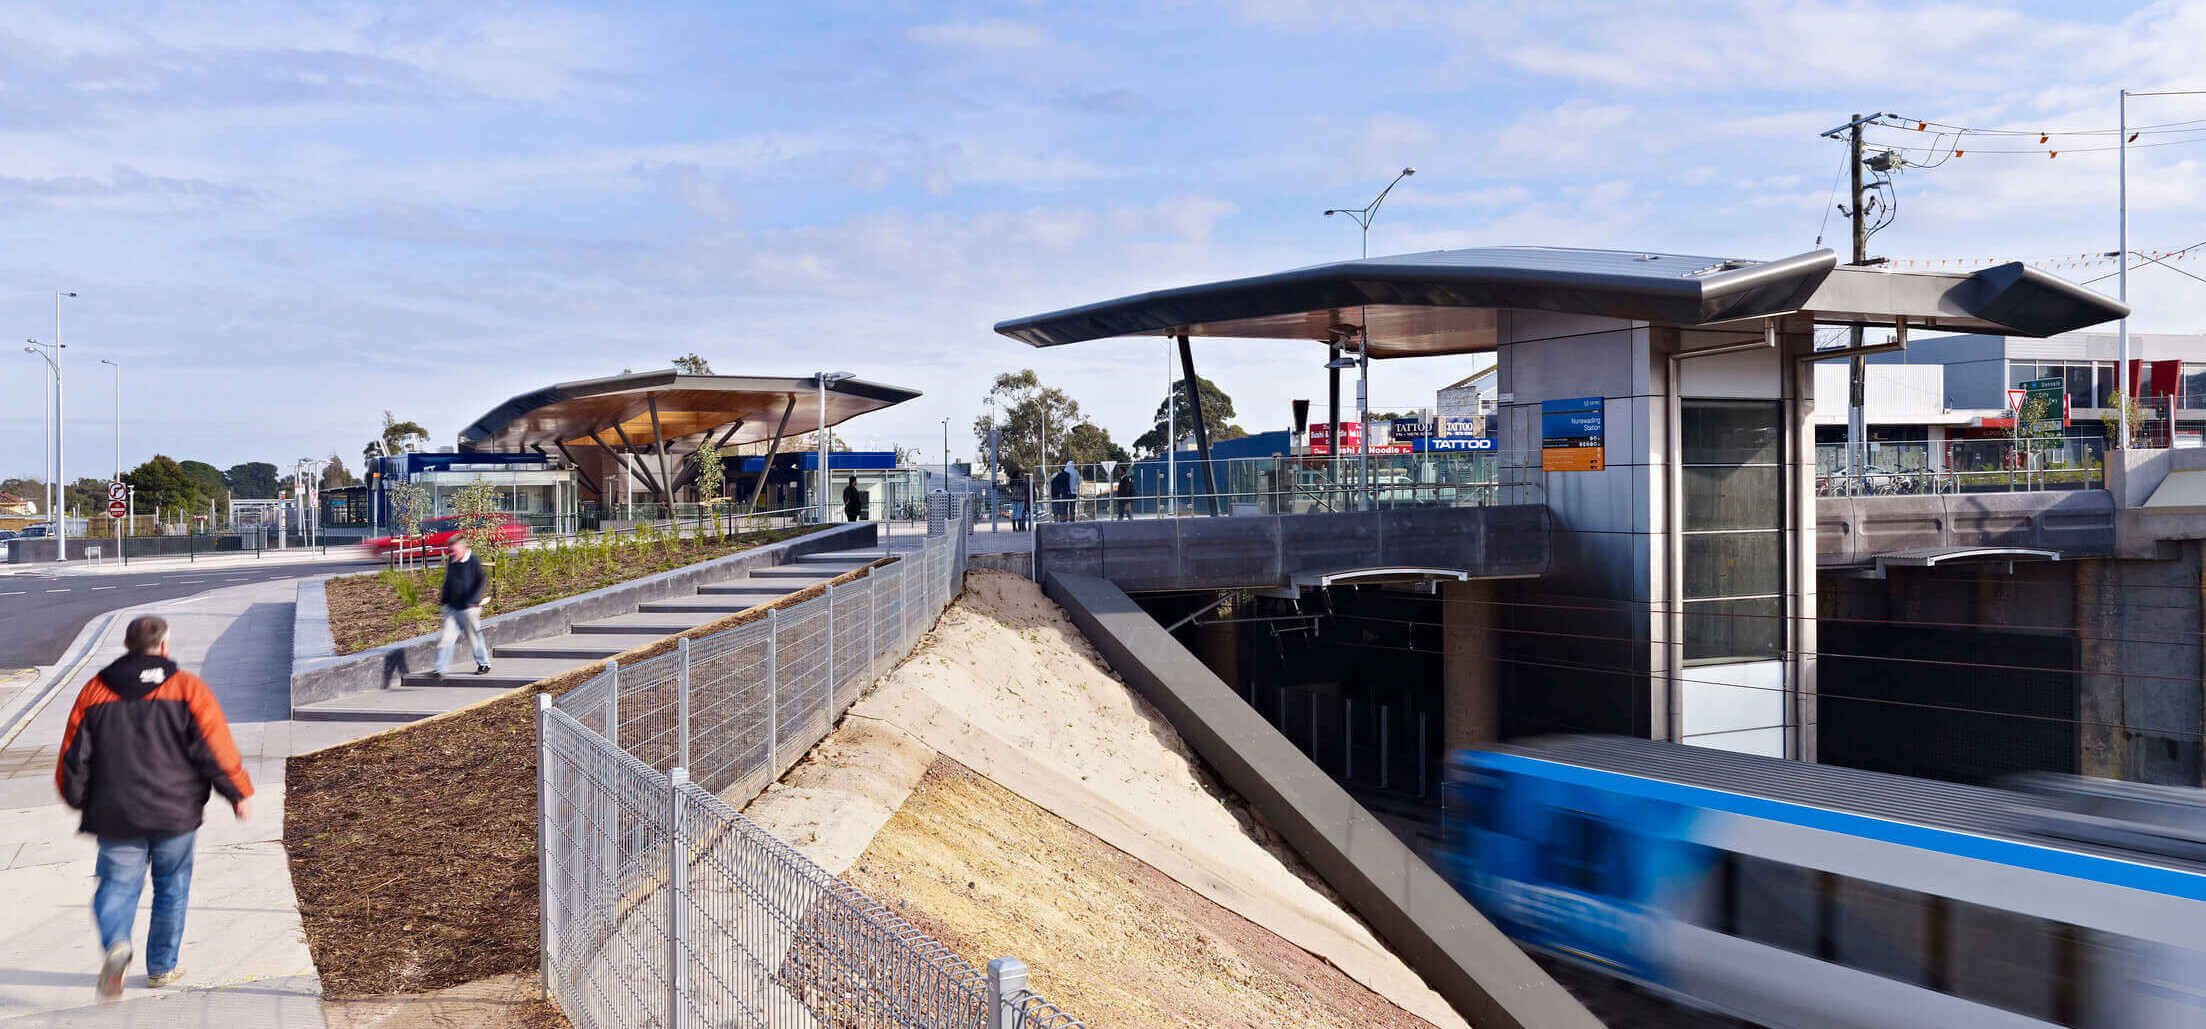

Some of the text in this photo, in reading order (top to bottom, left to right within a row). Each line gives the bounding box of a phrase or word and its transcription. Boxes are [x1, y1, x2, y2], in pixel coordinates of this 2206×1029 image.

[1571, 417, 1601, 425] Nunawading
[1395, 423, 1433, 432] TATTOO
[1446, 422, 1473, 431] TATTOO
[1432, 440, 1491, 449] TATTOO
[1368, 446, 1400, 454] Noodle
